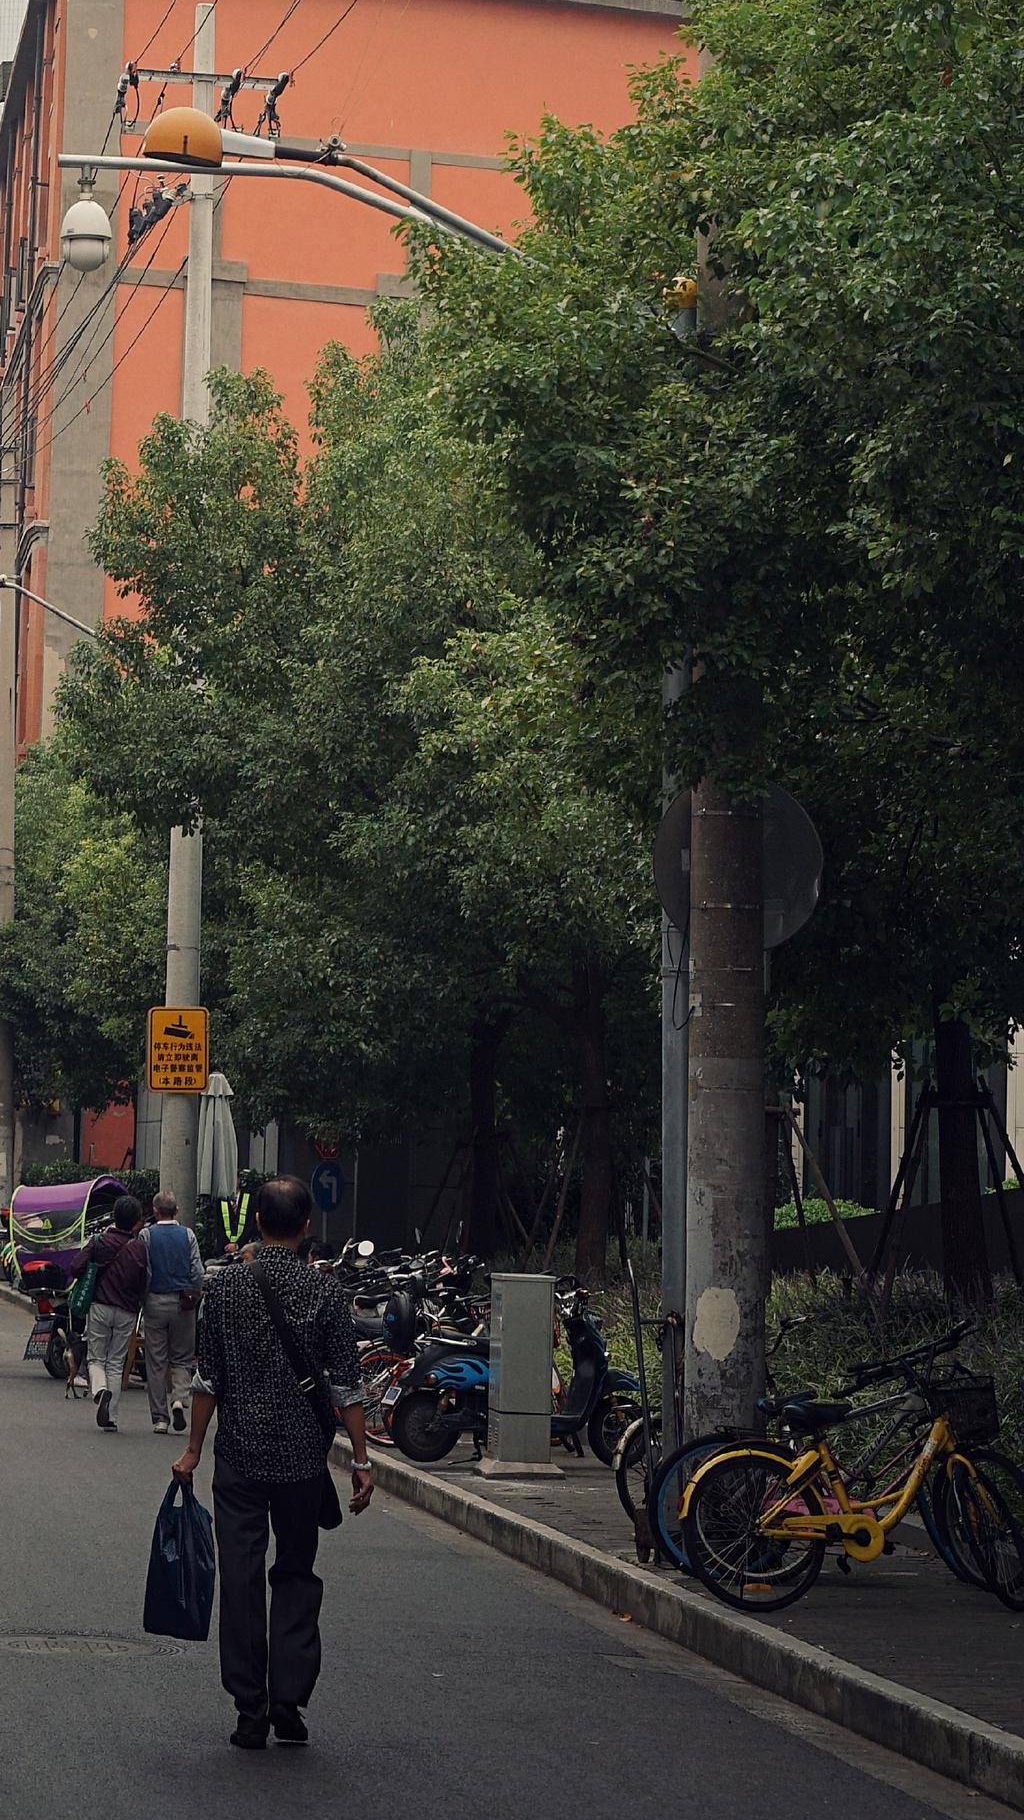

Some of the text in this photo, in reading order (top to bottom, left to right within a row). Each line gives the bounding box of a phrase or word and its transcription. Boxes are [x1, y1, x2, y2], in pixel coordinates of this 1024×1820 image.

[153, 1042, 202, 1052] 停车行为违法
[157, 1053, 199, 1062] 请立即驶离
[153, 1064, 203, 1073] 电子警察监管
